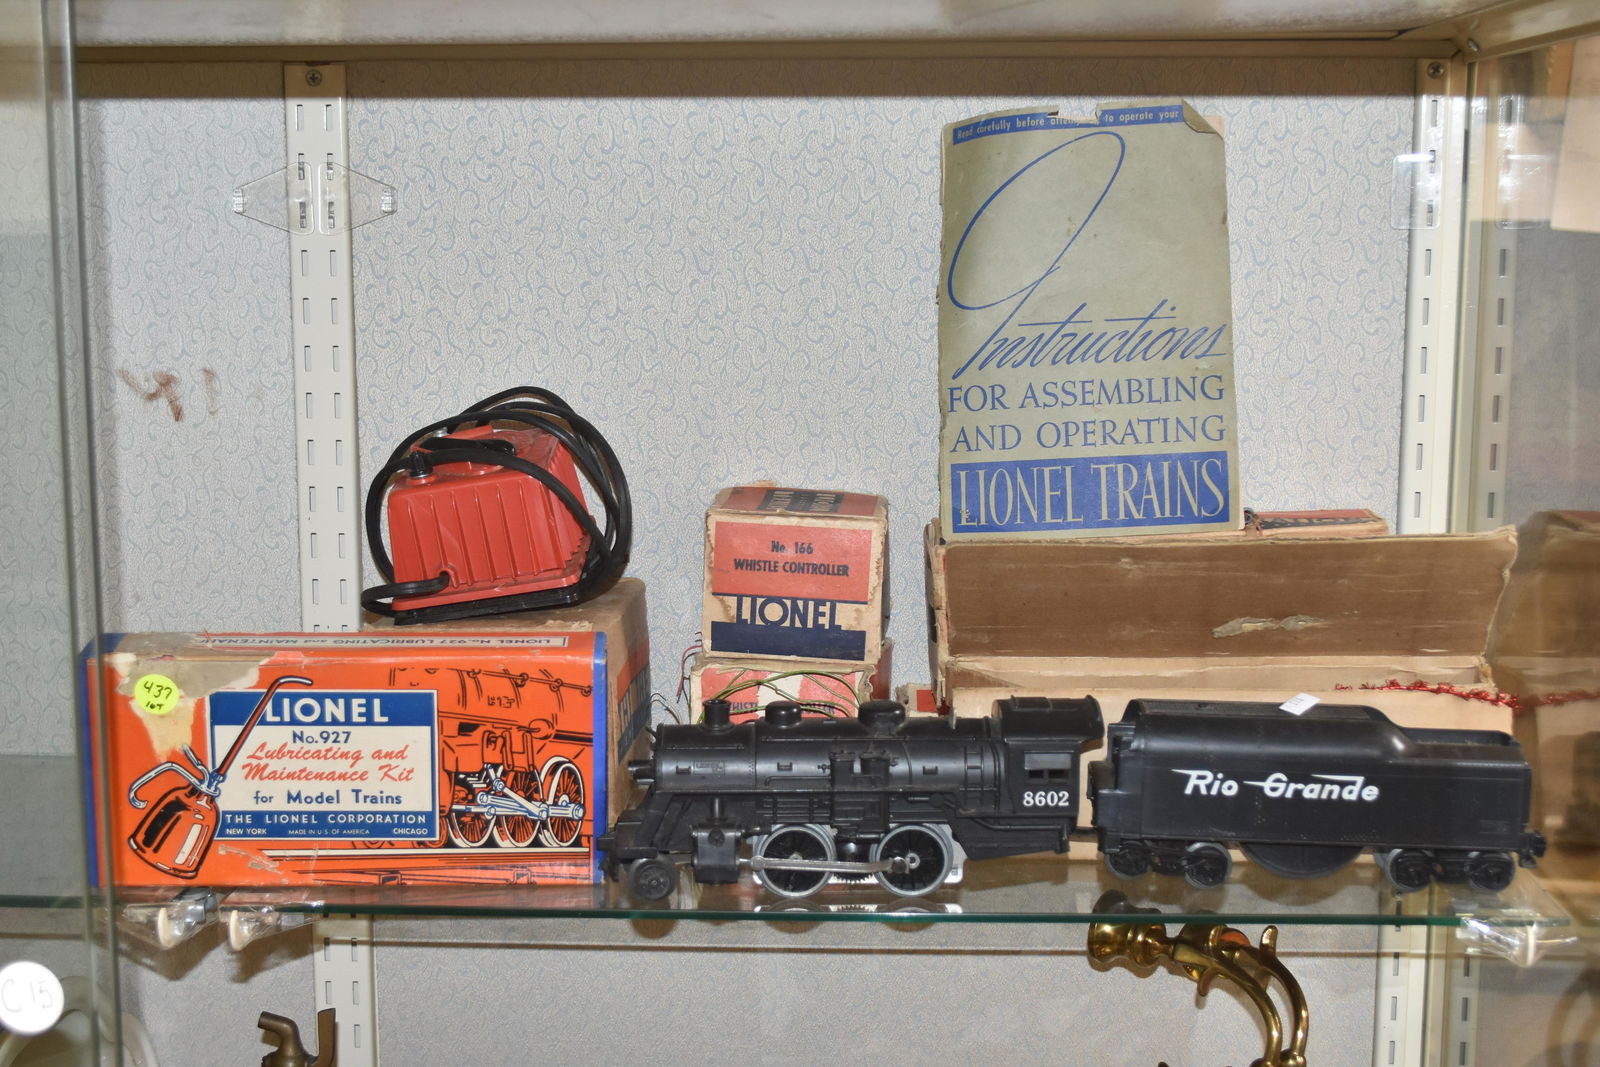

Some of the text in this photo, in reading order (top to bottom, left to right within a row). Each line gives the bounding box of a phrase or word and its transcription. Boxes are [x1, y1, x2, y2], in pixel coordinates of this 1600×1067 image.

[957, 127, 973, 139] Read
[976, 119, 1011, 133] carefully
[1016, 115, 1045, 128] before
[1104, 113, 1114, 122] to
[1119, 111, 1154, 122] operate
[1159, 110, 1180, 120] your
[948, 131, 1227, 380] Instructions
[948, 375, 1225, 412] FOR ASSEMBLING
[951, 414, 1226, 452] AND OPERATING
[956, 458, 1225, 527] LIONEL TRAINS
[794, 542, 814, 554] 166
[733, 558, 849, 577] WHISTLE CONTROLLER
[736, 596, 842, 630] LIONEL
[143, 681, 173, 700] 437
[265, 698, 389, 723] LIONEL
[246, 742, 409, 767] Lubricating and
[241, 763, 415, 782] Maintenance Kit
[1171, 769, 1380, 801] Rio Grande
[253, 789, 402, 805] for Model Trains
[1023, 791, 1070, 806] 8602
[225, 814, 426, 824] THE LIONEL CORPORATION
